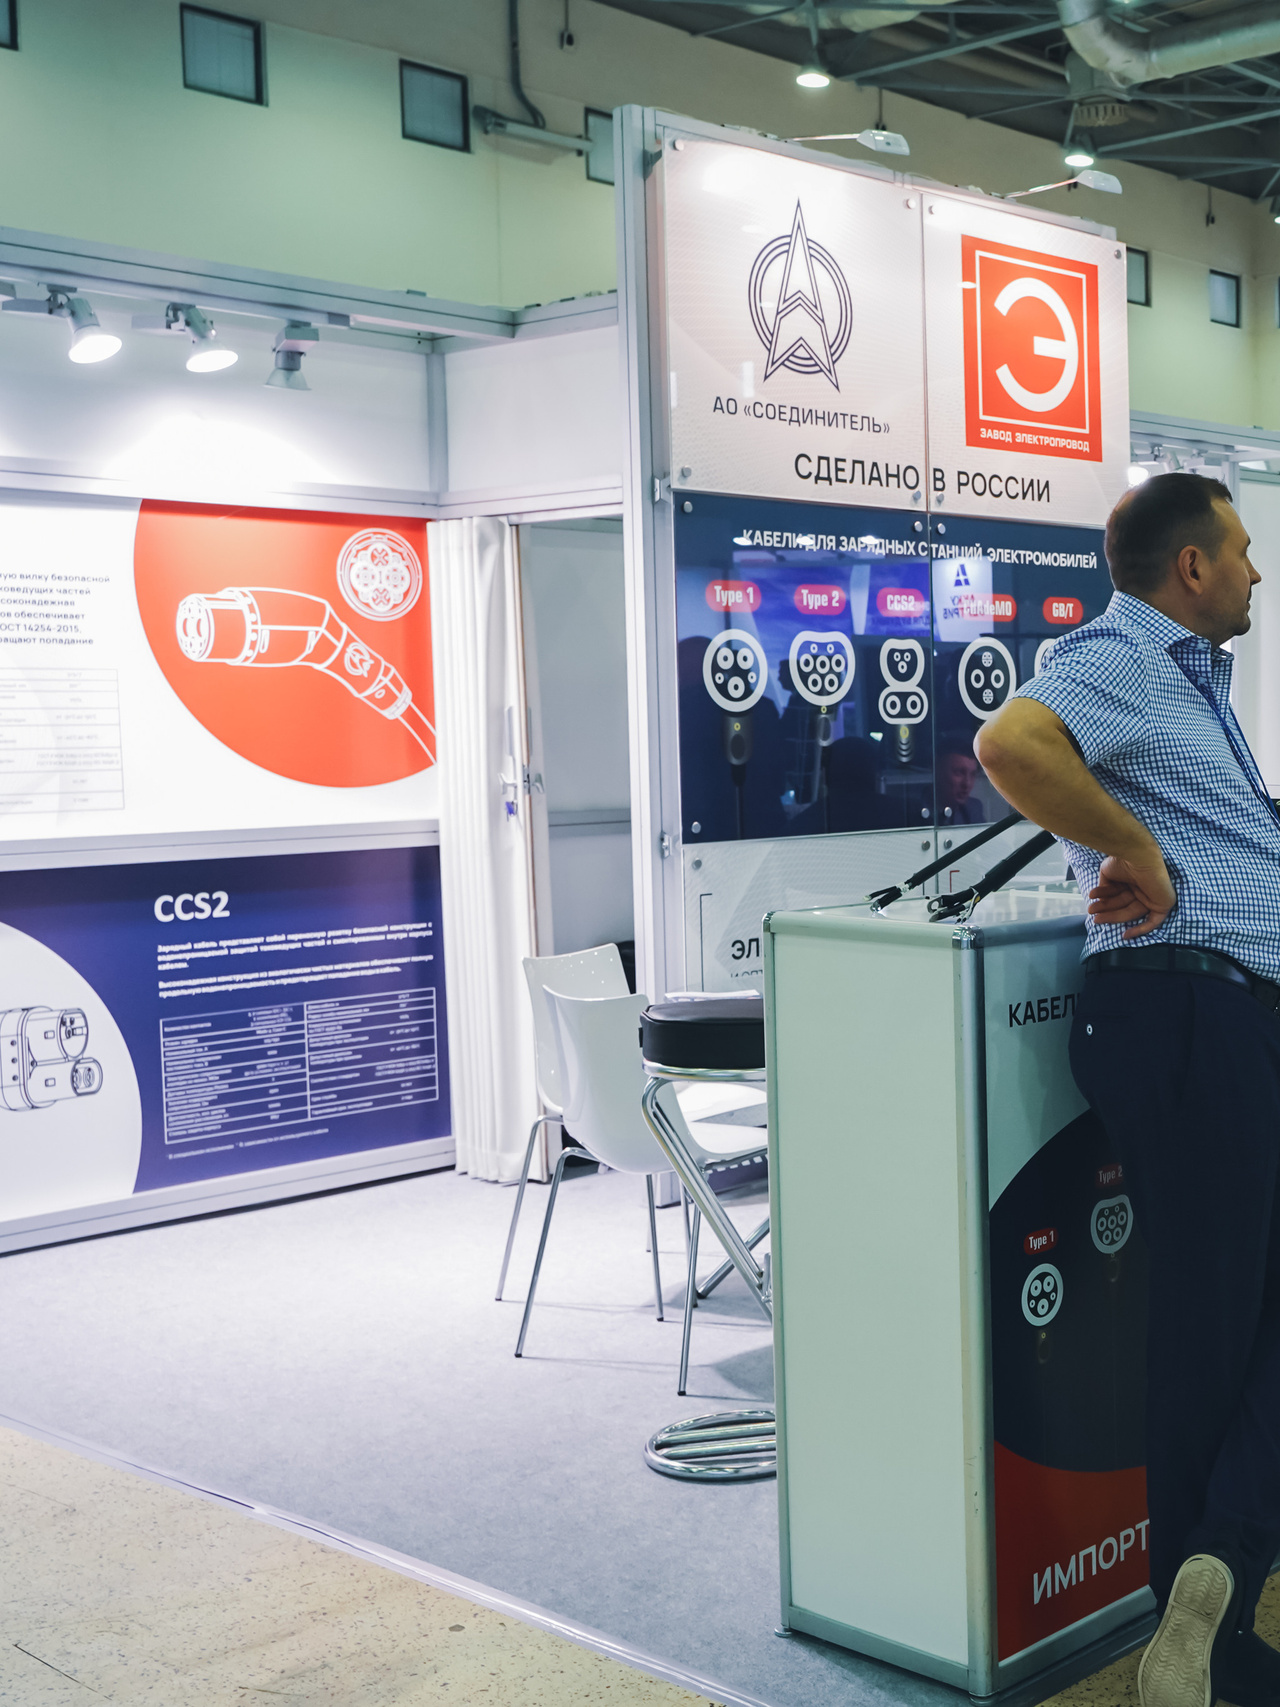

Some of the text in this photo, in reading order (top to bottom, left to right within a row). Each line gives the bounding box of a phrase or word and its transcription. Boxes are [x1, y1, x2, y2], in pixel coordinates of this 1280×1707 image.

[712, 396, 890, 434] АО «СОЕДИНИТЕЛЬ»
[980, 428, 1090, 453] ЗАВОД ЭЛЕКТРОПРОВОД
[794, 453, 1051, 503] СДЕЛАНО В РОССИИ
[918, 541, 982, 561] СТАНЦИЙ
[987, 547, 1097, 569] ЭЛЕКТРОМОБИЛЕЙ
[19, 573, 49, 582] вилку
[51, 573, 110, 584] безопасной
[56, 586, 91, 596] частей
[714, 586, 755, 607] Type 1
[801, 589, 840, 610] Type 2
[886, 594, 916, 612] CCS2
[1052, 602, 1075, 620] GB/T
[14, 610, 85, 620] обеспечивает
[39, 636, 94, 646] попадание
[154, 891, 230, 922] CCS2
[1008, 993, 1081, 1028] КАБЕЛ
[1098, 1165, 1124, 1185] Type 2
[1028, 1231, 1055, 1250] Type 1
